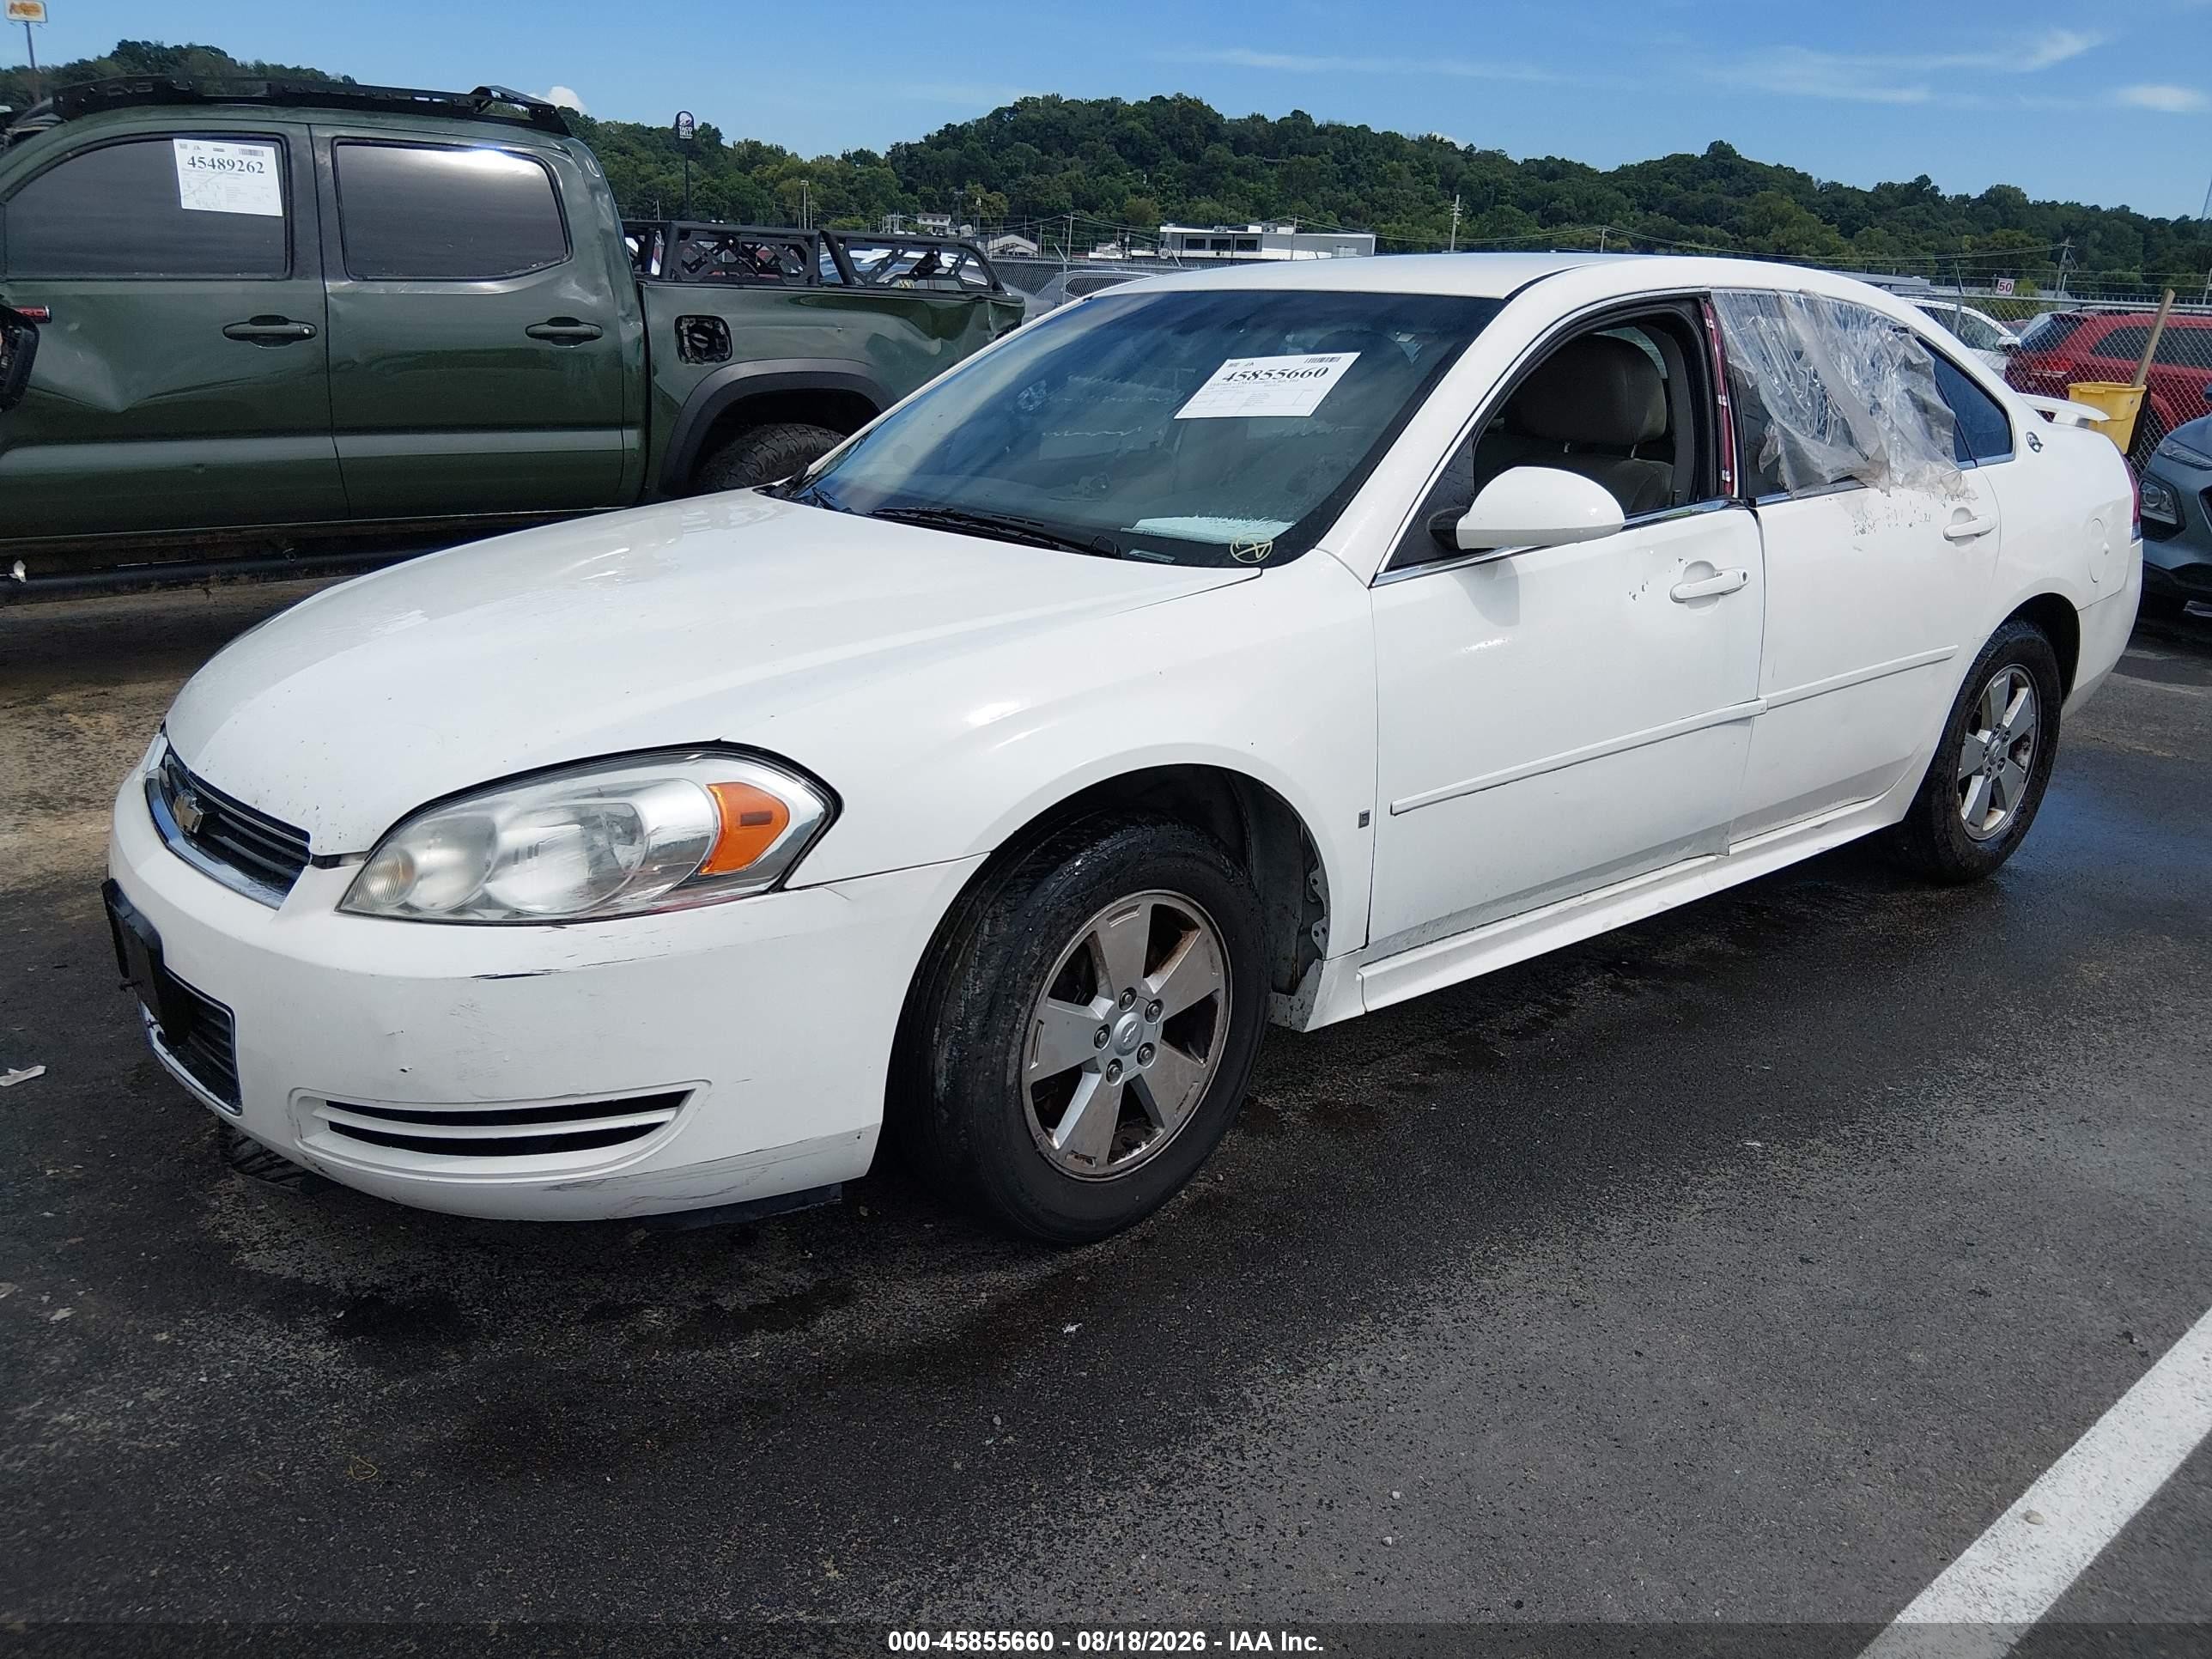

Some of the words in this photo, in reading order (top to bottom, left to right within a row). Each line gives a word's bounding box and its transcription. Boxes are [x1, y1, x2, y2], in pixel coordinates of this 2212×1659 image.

[187, 155, 264, 173] 45489262
[1998, 282, 2012, 292] 50
[1222, 367, 1329, 382] 45855660
